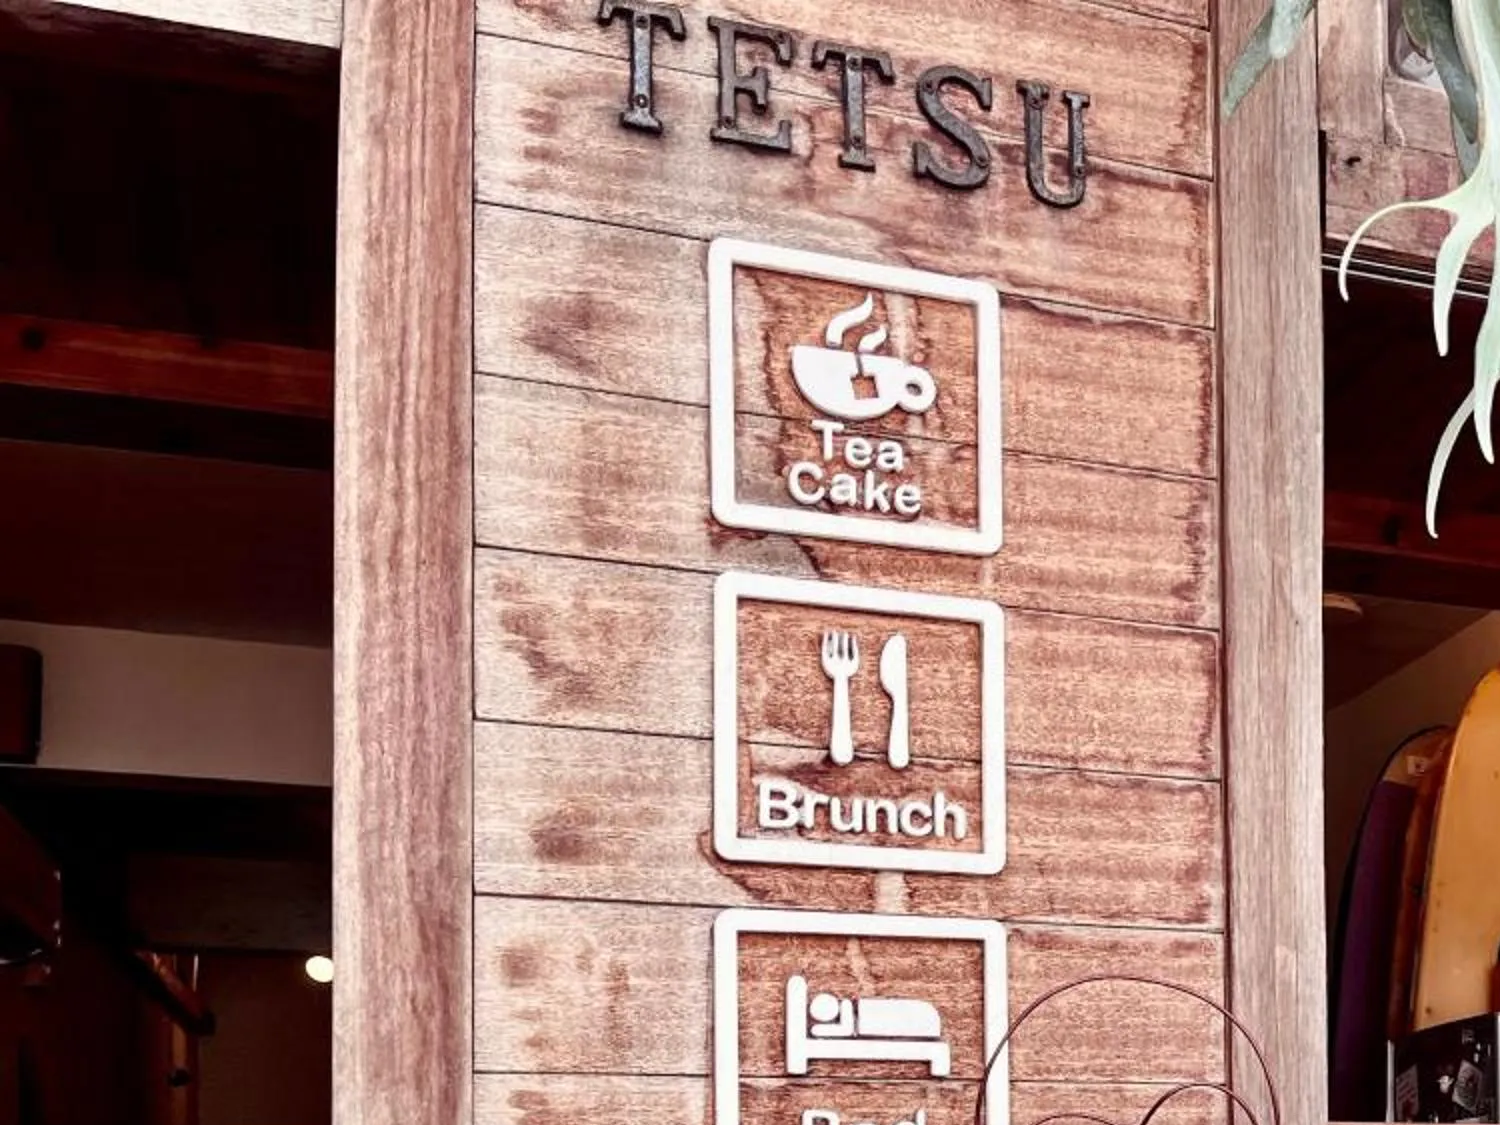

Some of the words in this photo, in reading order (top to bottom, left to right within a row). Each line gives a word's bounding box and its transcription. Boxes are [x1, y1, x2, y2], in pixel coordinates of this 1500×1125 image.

[596, 1, 1090, 207] TETSU
[811, 419, 905, 472] Tea
[787, 462, 922, 514] Cake
[757, 779, 968, 839] Brunch
